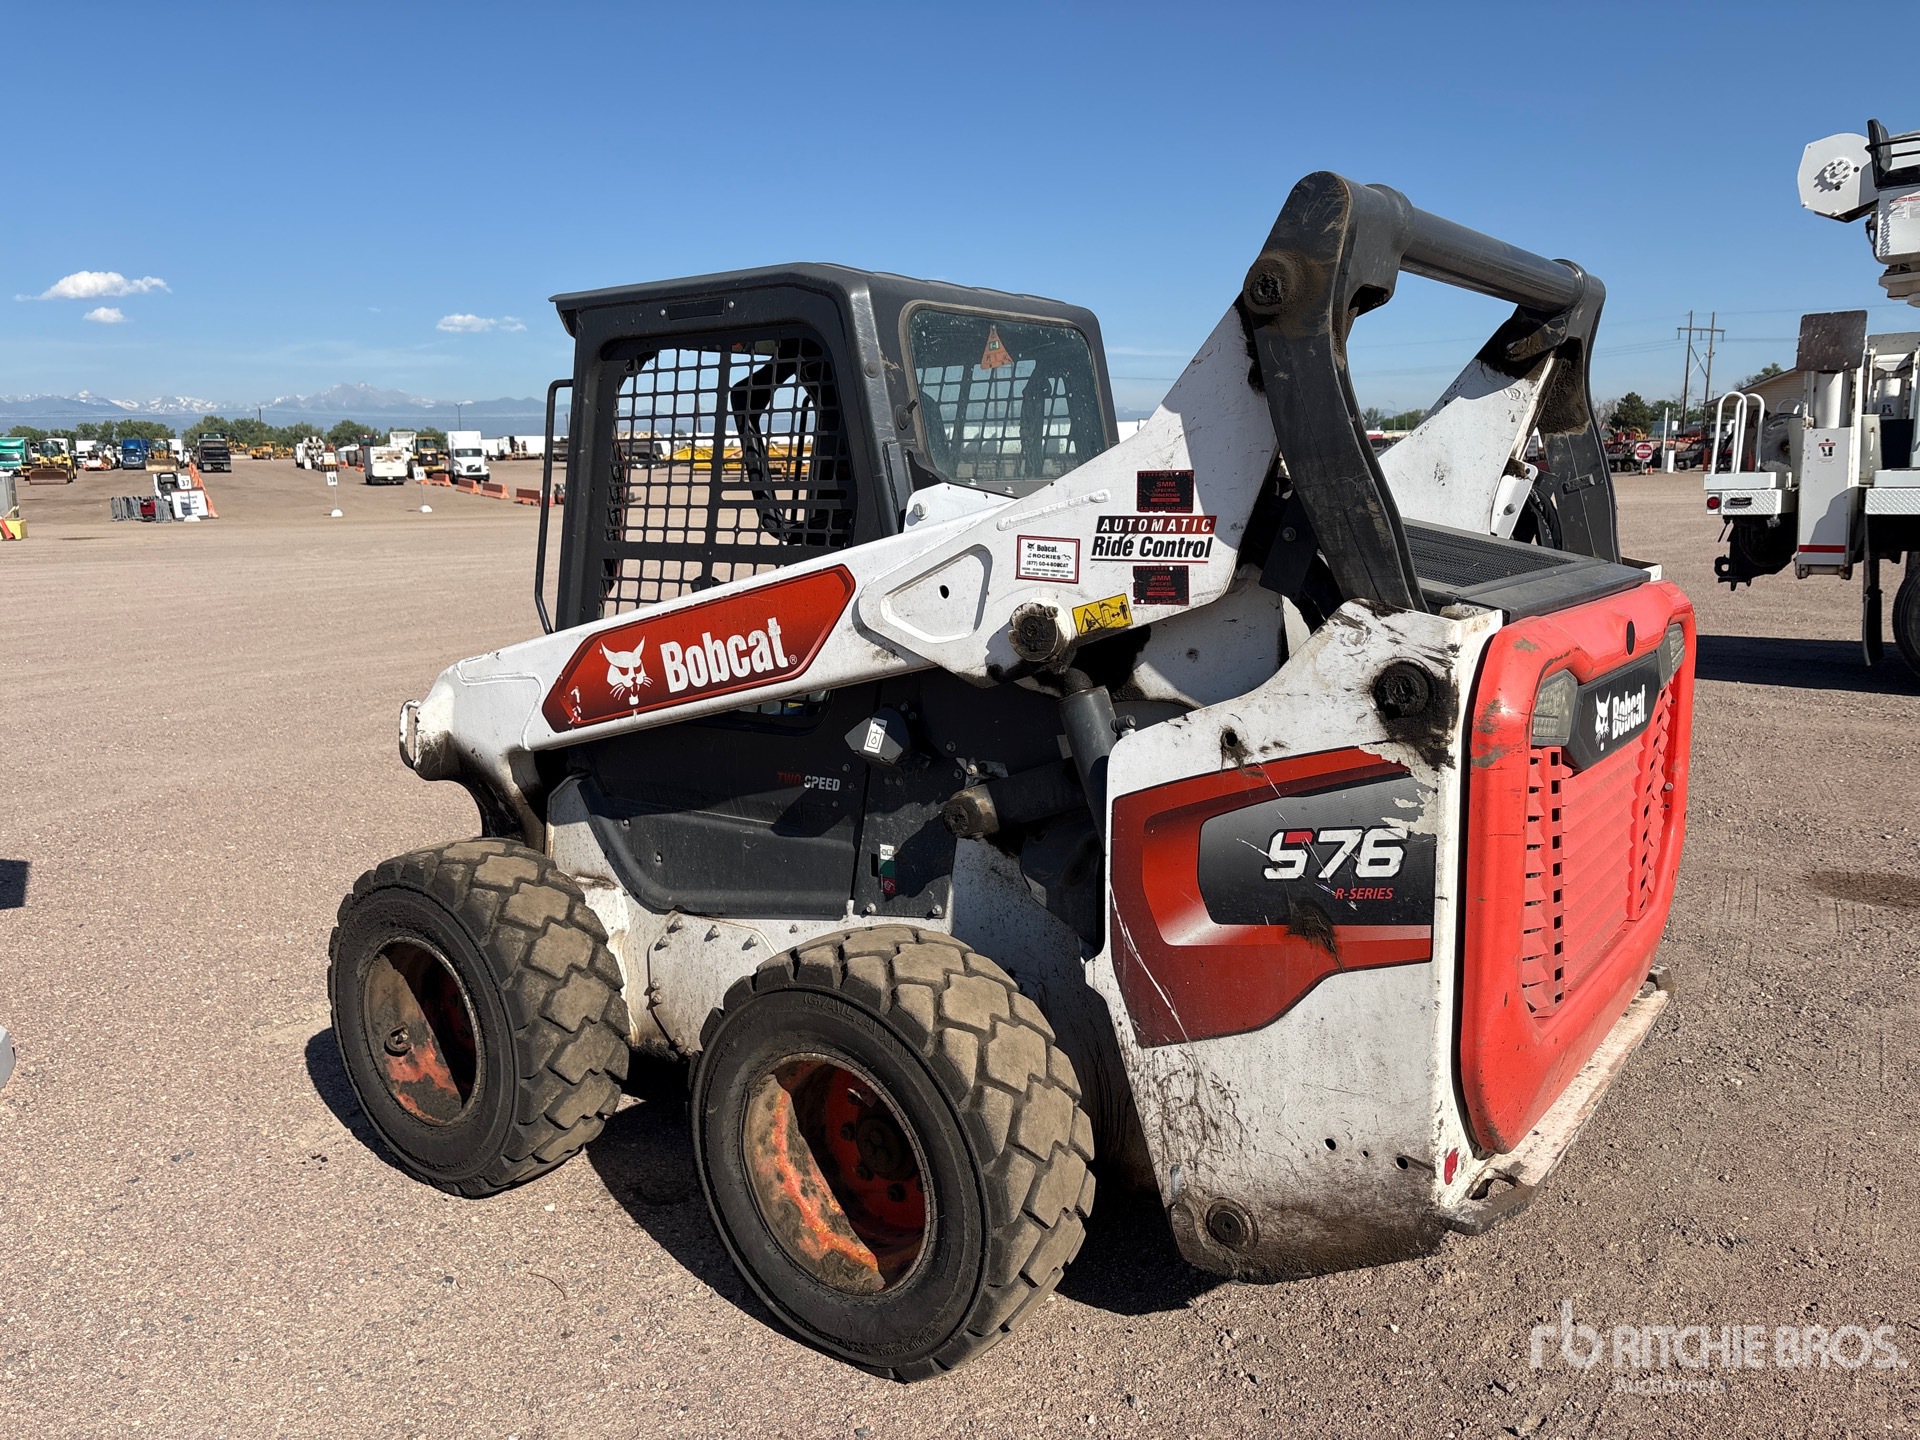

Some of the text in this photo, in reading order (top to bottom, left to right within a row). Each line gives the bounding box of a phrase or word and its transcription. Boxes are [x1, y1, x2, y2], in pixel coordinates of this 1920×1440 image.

[1100, 518, 1212, 532] AUTOMATIC
[1036, 544, 1057, 553] Bobcat
[1092, 535, 1214, 558] Ride Control
[660, 616, 788, 694] Bobcat
[1612, 684, 1646, 741] Bobcat
[777, 771, 841, 792] TWO SPEED
[1263, 828, 1409, 880] S76
[1335, 887, 1394, 900] R-SERIES
